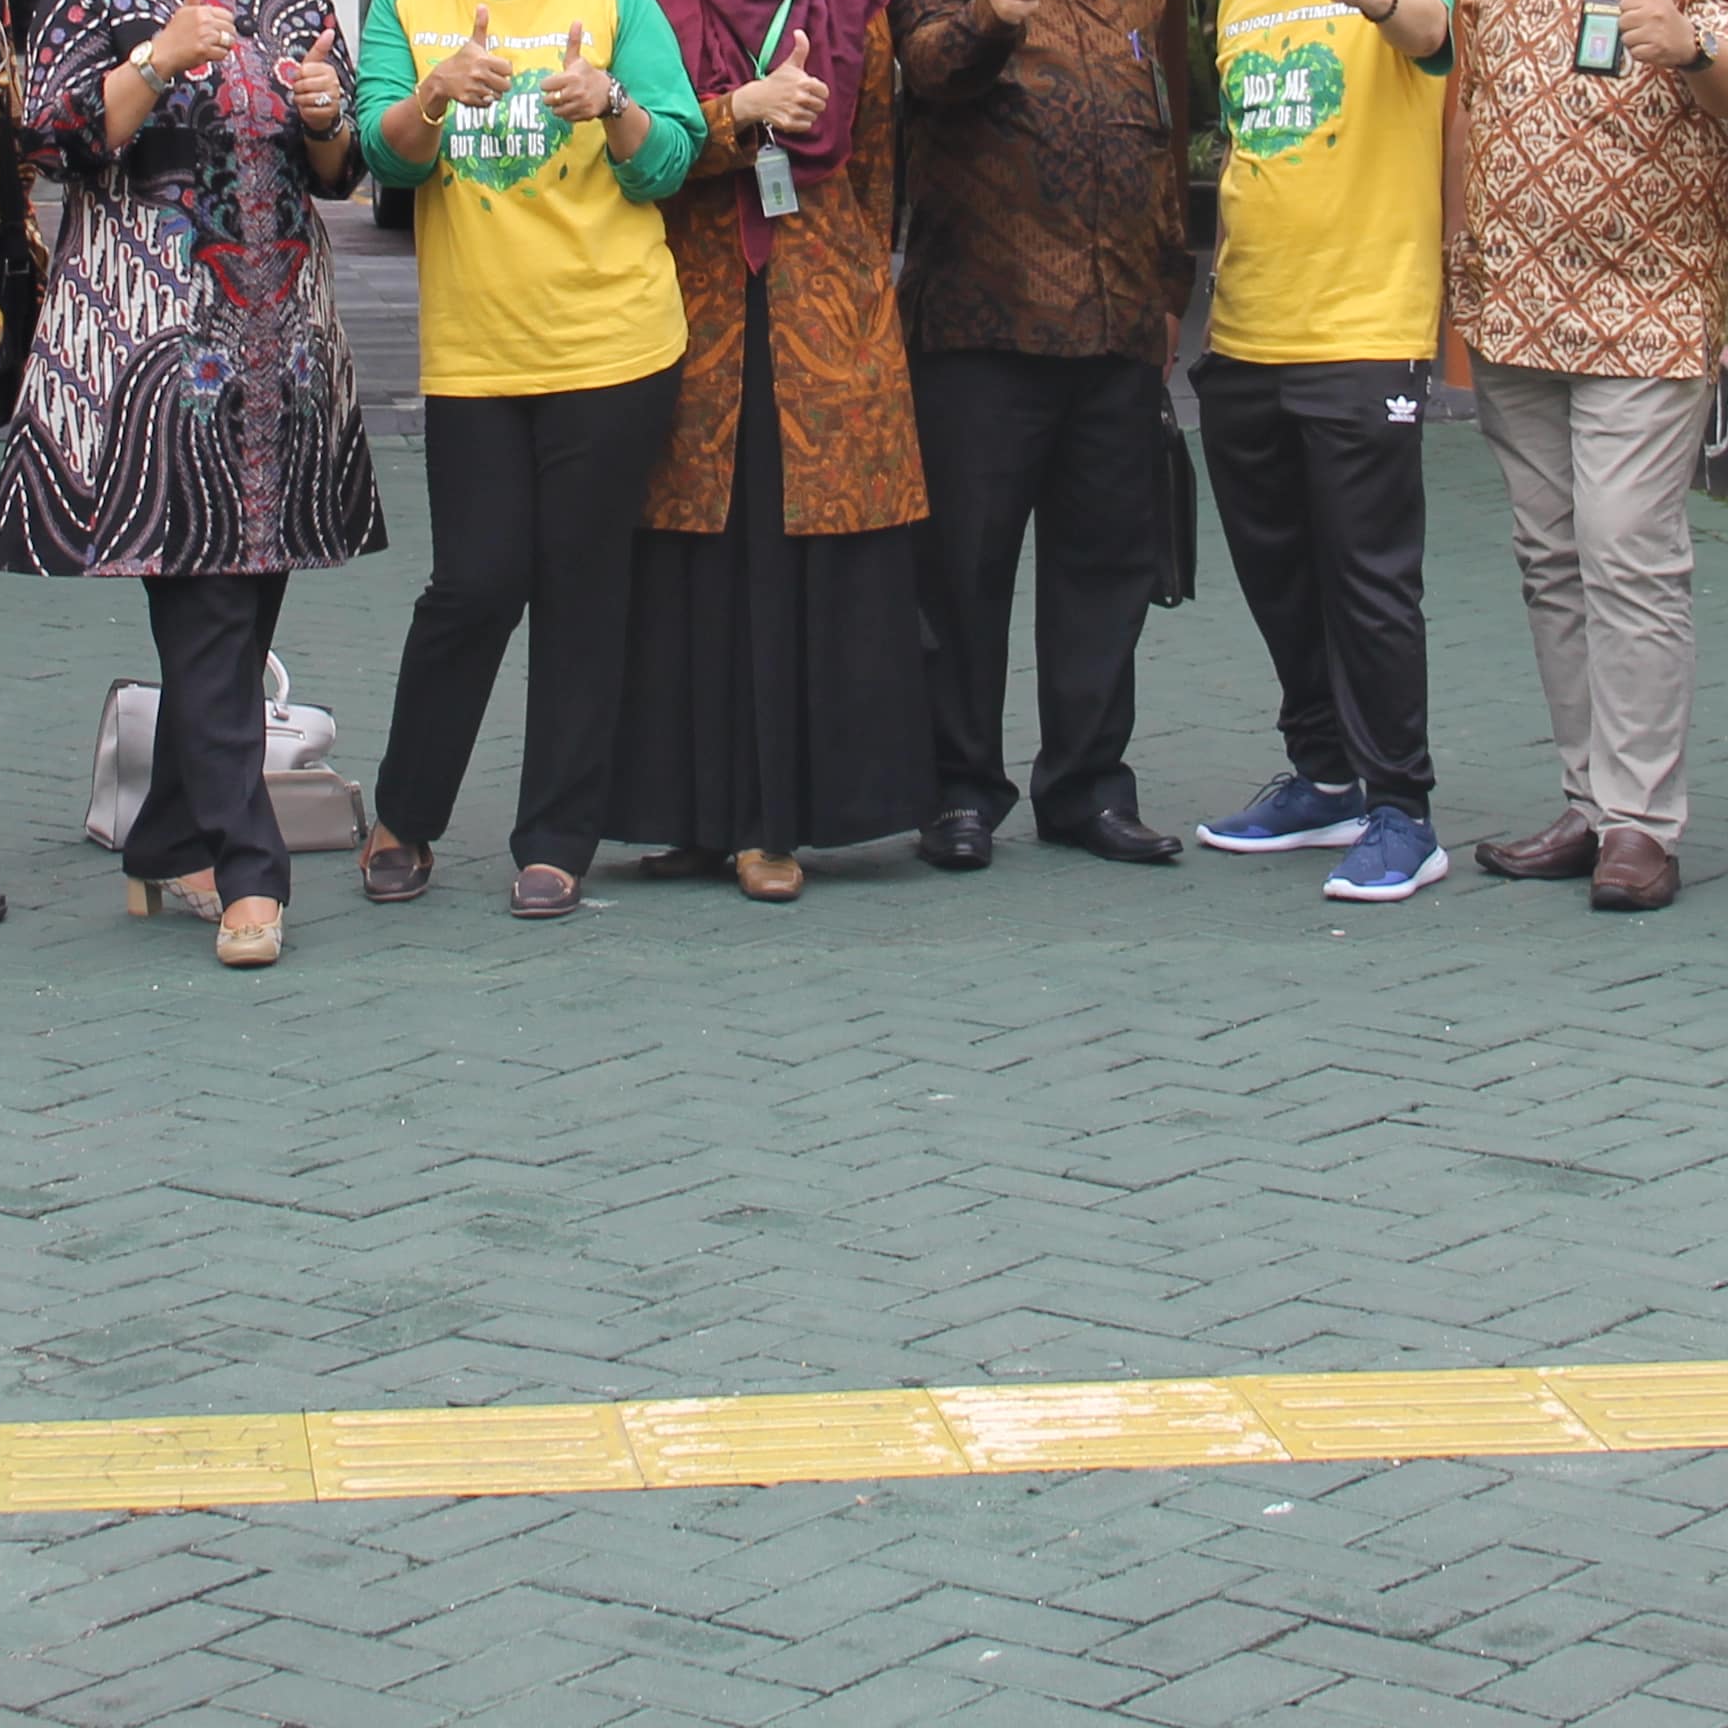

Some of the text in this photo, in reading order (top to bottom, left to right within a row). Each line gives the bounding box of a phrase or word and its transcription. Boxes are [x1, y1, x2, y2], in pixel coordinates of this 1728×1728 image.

[414, 32, 438, 46] PN
[504, 32, 593, 49] ISTIMEA
[1243, 69, 1312, 108] NOT ME,
[509, 93, 545, 132] ME,
[1275, 105, 1292, 127] OF
[1295, 104, 1313, 127] US
[450, 132, 545, 159] BUT ALL OF US
